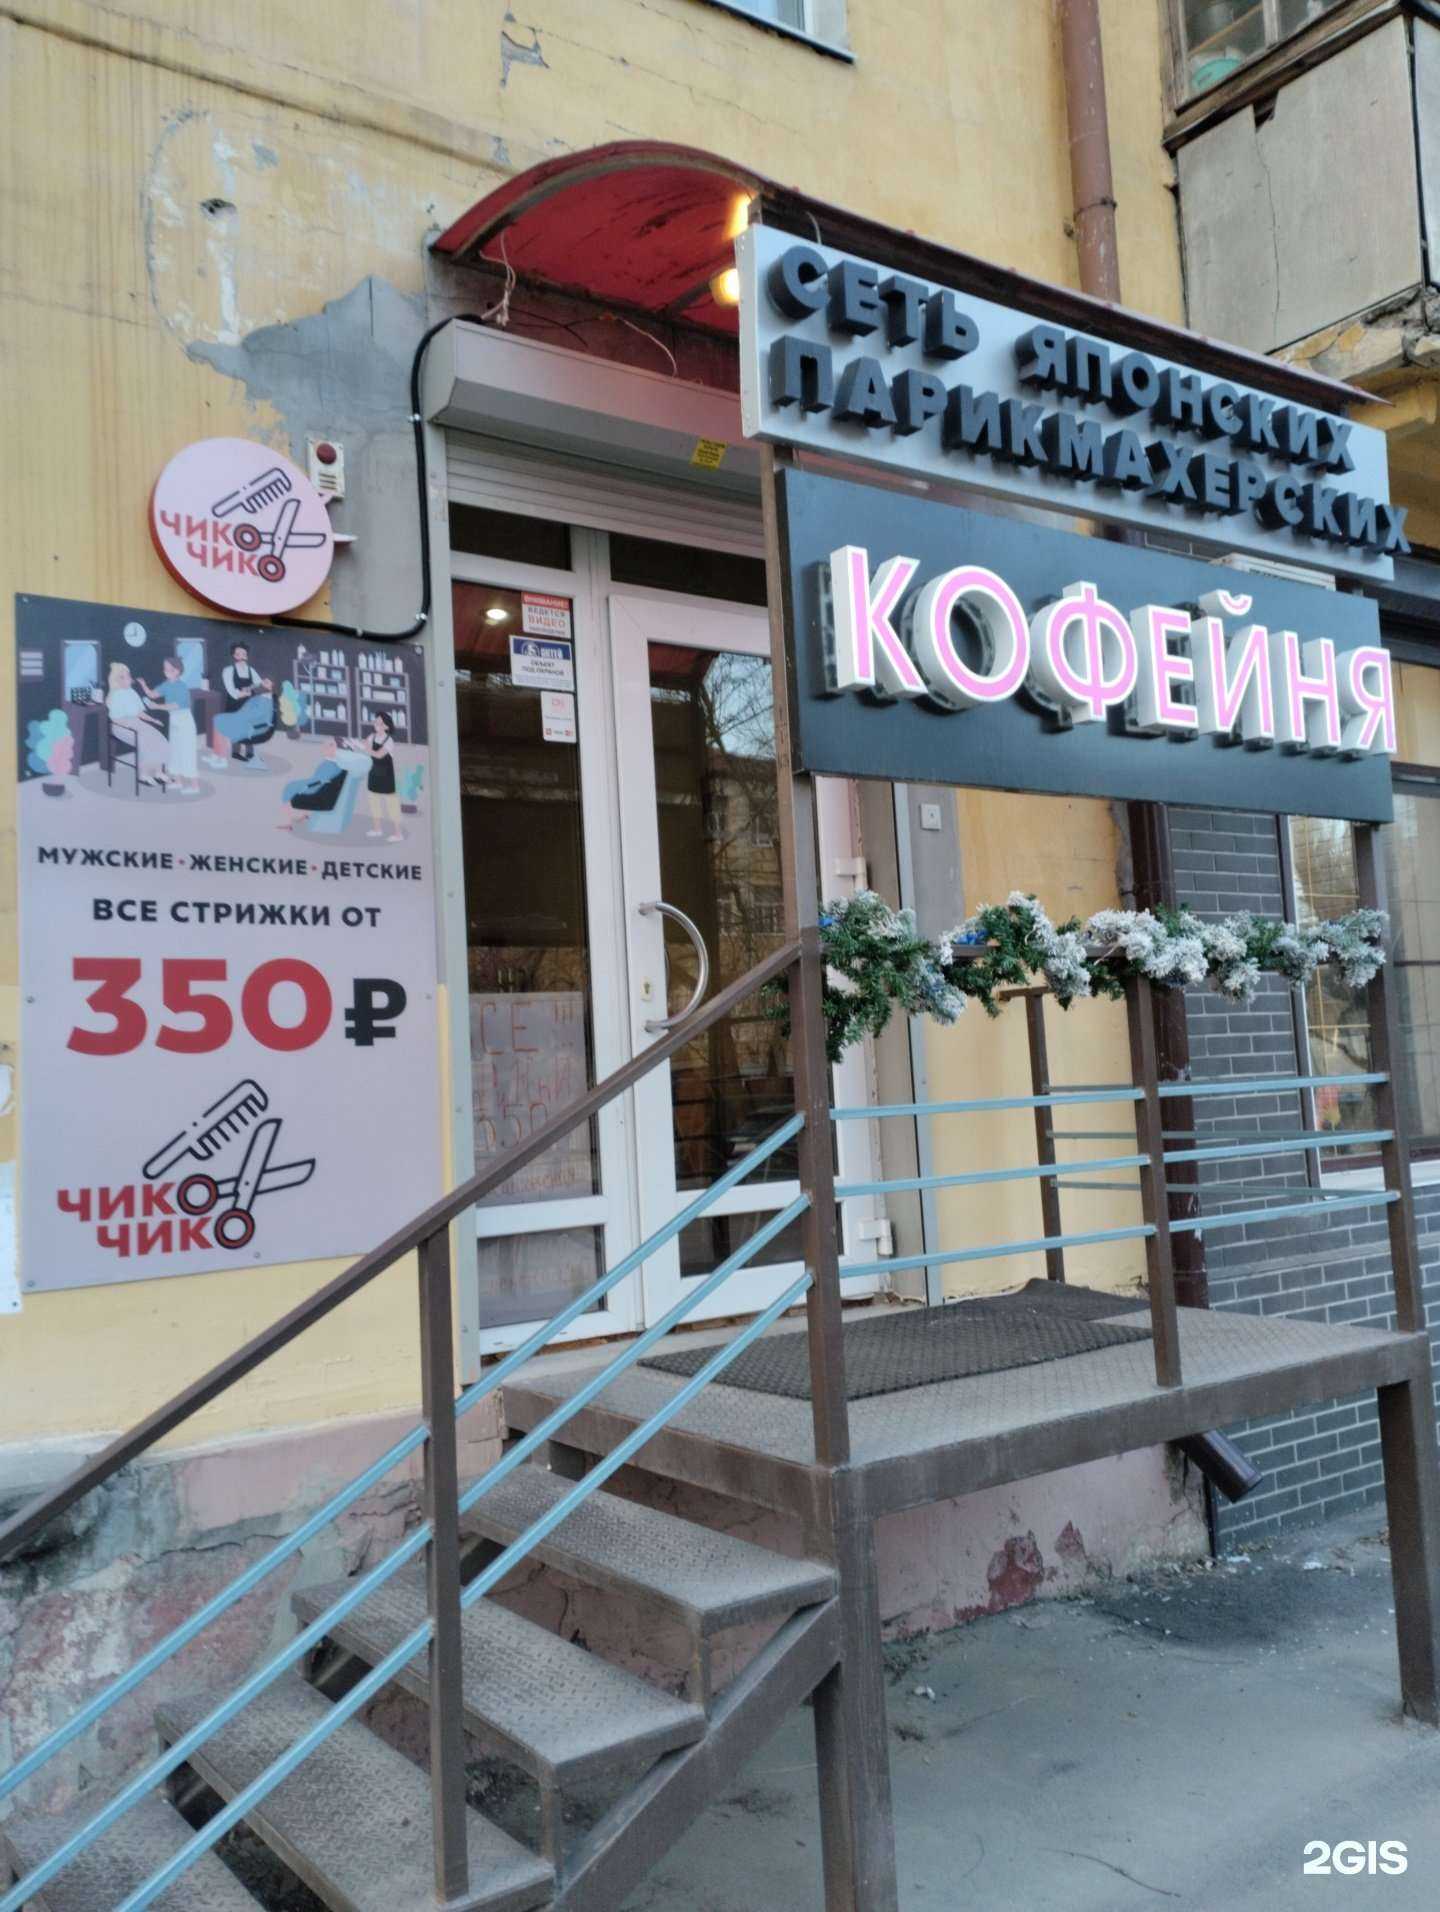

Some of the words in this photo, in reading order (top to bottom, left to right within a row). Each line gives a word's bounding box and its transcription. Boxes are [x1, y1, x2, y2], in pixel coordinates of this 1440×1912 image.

[768, 245, 979, 360] СЕТЬ
[1015, 324, 1355, 475] ЯПОНСКИХ
[768, 335, 1412, 554] ПАРИКМАХЕРСКИХ
[160, 510, 233, 546] ЧИК
[186, 542, 258, 577] ЧИК
[830, 545, 1397, 755] КОФЕЙНЯ
[37, 846, 174, 871] МУЖСКИЕ
[189, 854, 308, 875] ЖЕНСКИЕ
[321, 860, 422, 881] ДЕТСКИЕ
[92, 898, 157, 921] ВСЕ
[170, 901, 331, 926] СТРИЖКИ
[341, 907, 382, 928] ОТ
[57, 1182, 177, 1222] ЧИК
[96, 1217, 214, 1258] ЧИК
